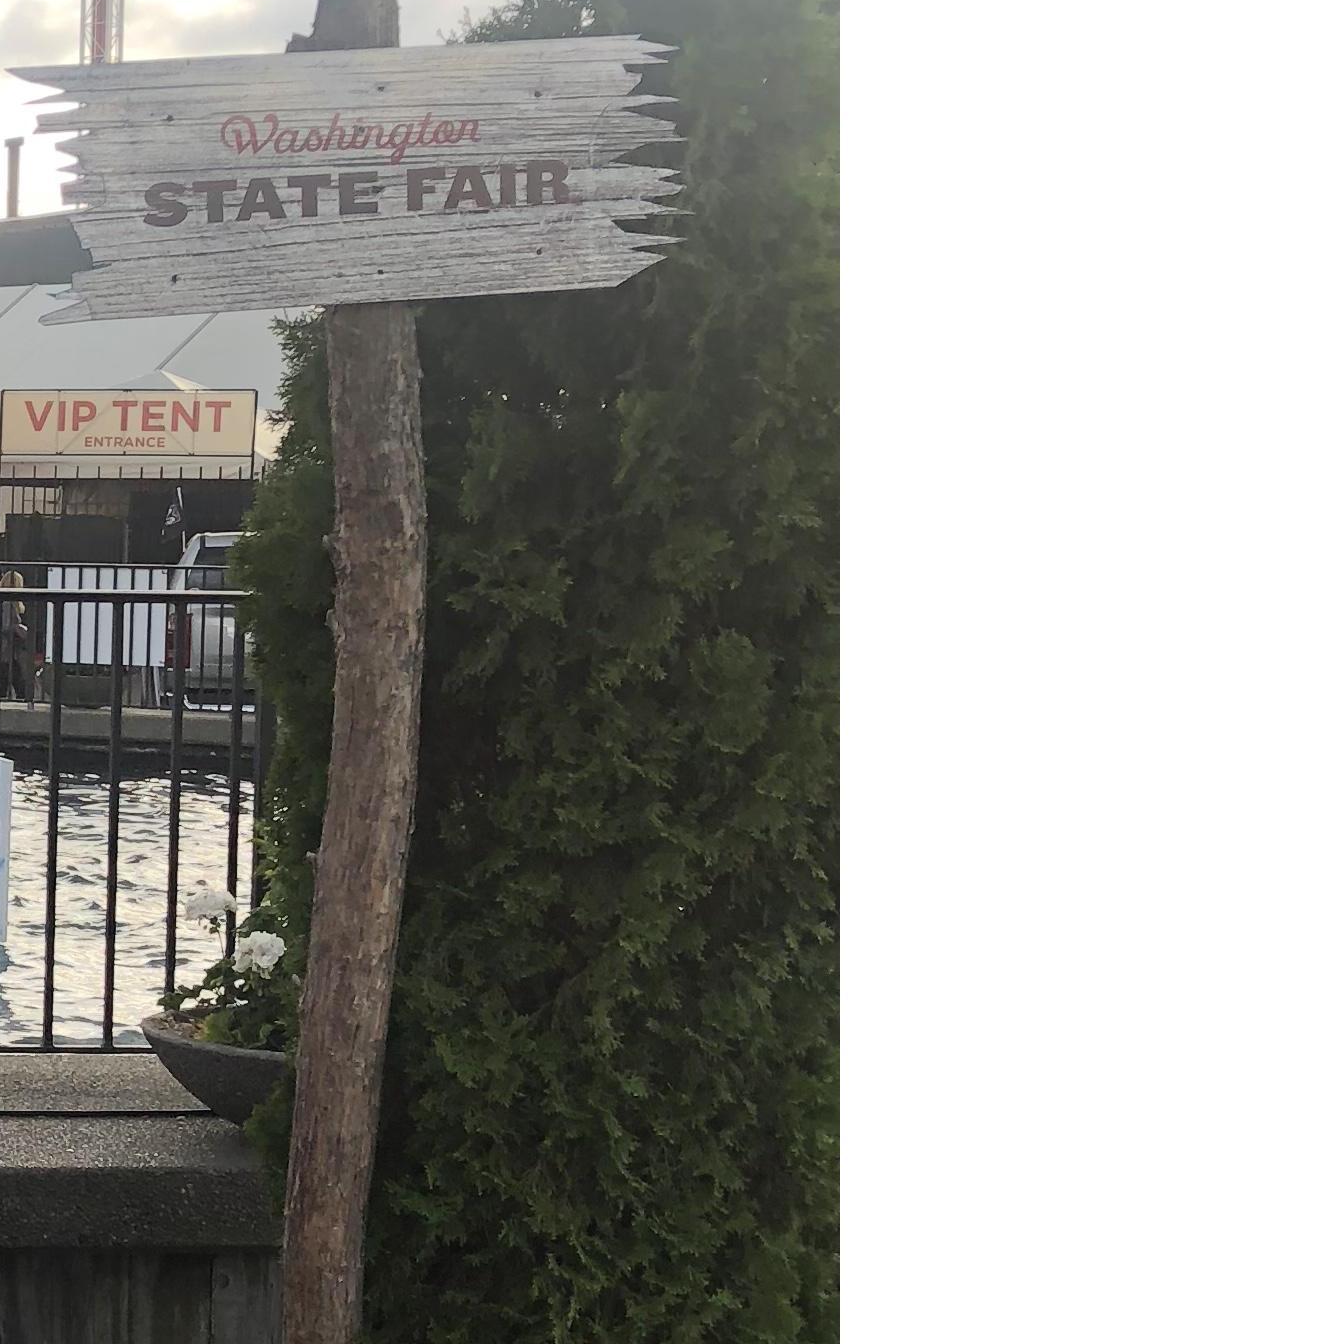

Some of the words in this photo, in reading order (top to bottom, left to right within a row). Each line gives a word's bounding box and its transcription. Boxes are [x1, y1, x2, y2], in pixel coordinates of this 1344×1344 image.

[220, 112, 482, 165] Washington
[143, 171, 379, 227] STATE
[407, 159, 569, 211] FAIR
[24, 400, 97, 432] VIP
[112, 400, 232, 433] TENT
[84, 436, 166, 448] ENTRANCE
